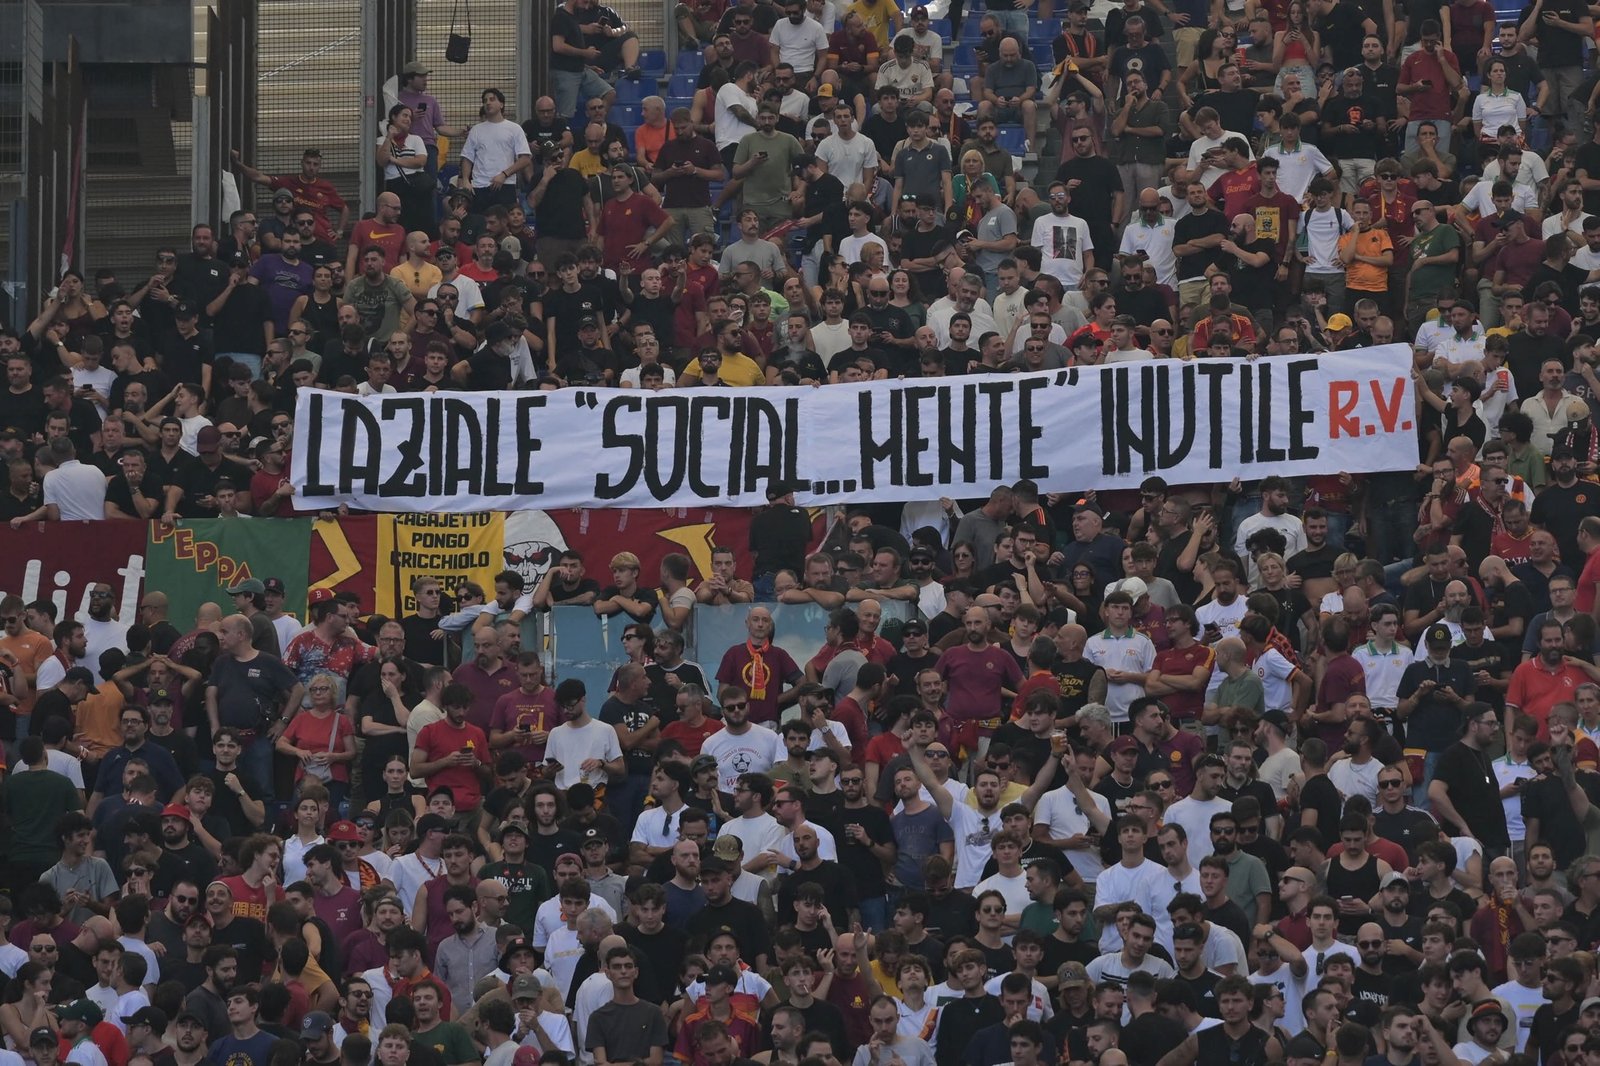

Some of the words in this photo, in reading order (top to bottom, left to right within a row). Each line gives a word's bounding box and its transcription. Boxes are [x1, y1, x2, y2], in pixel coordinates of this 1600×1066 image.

[302, 393, 547, 497] LAZIALE
[1100, 359, 1320, 476] INUTILE
[1329, 377, 1413, 439] R.V.
[151, 518, 253, 589] PEPPA
[411, 532, 470, 549] PONGO
